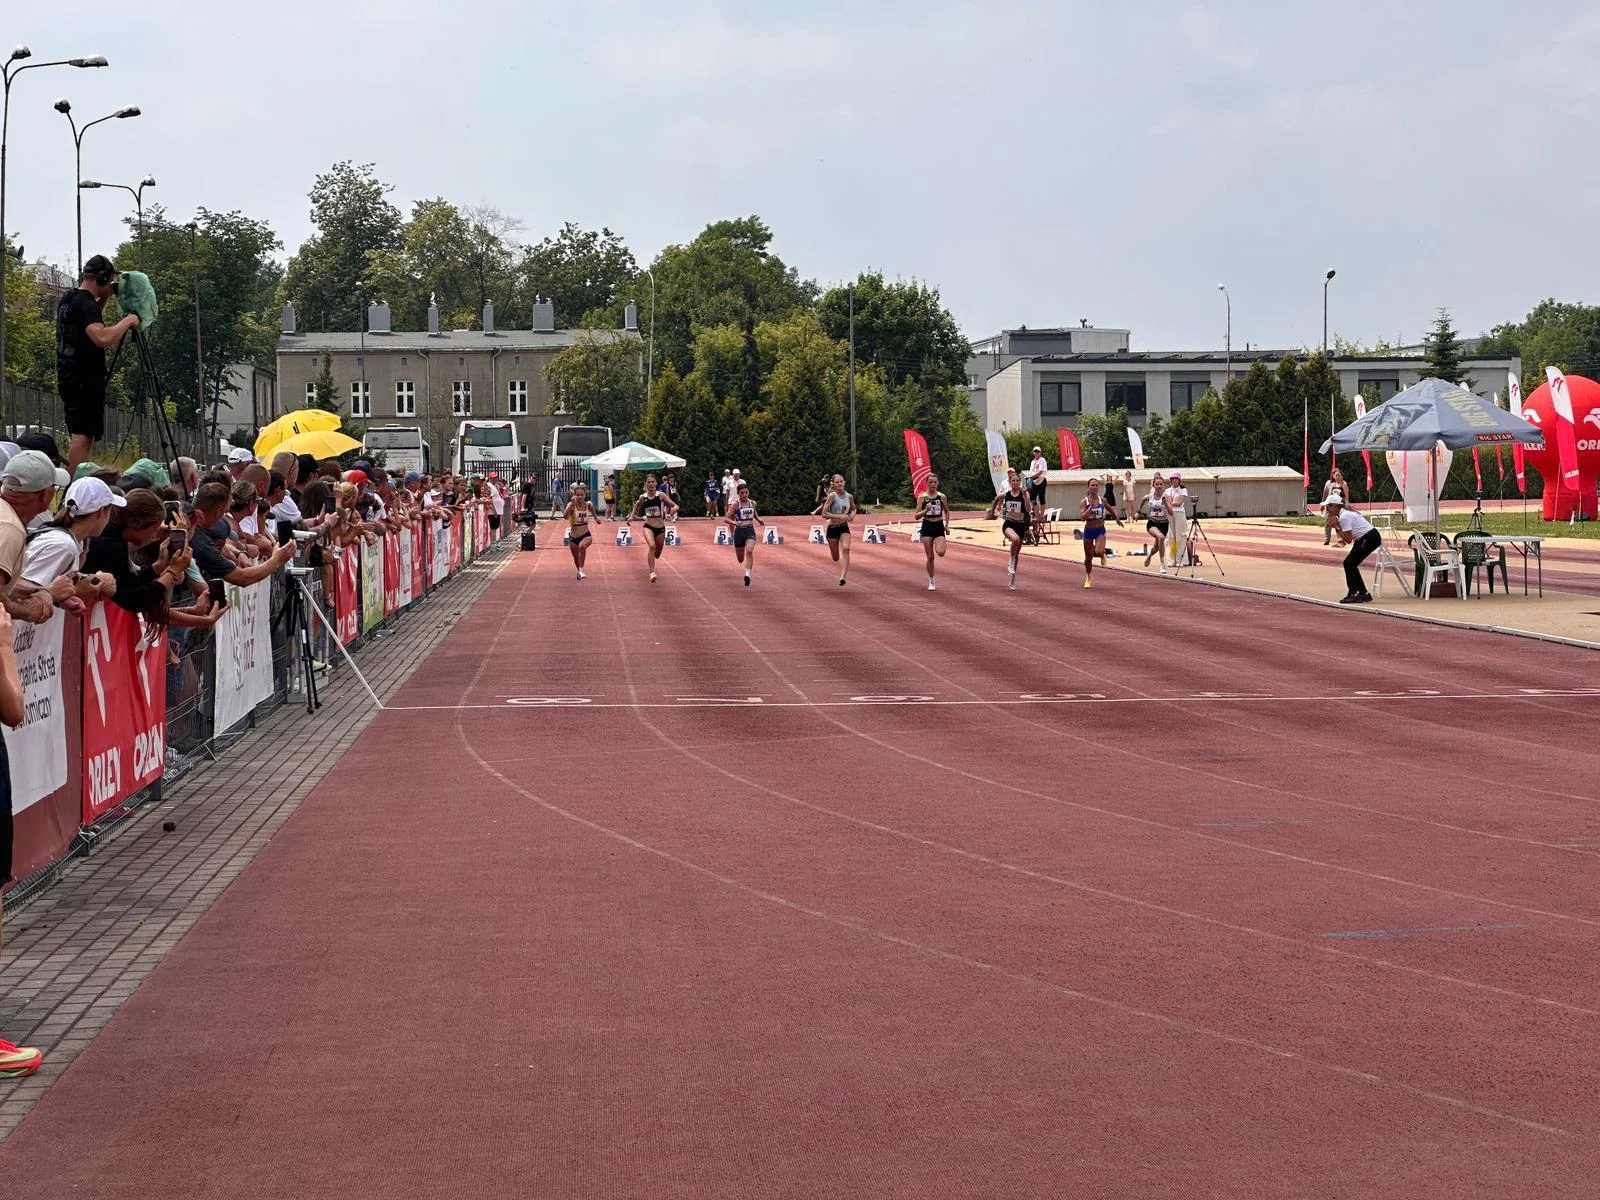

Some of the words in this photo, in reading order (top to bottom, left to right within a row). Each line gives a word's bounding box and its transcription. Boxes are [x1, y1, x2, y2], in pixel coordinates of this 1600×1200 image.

[620, 531, 628, 541] 7
[667, 530, 675, 542] 6
[719, 530, 727, 541] 5
[767, 529, 775, 539] 4
[814, 529, 821, 540] 3
[867, 529, 875, 540] 2
